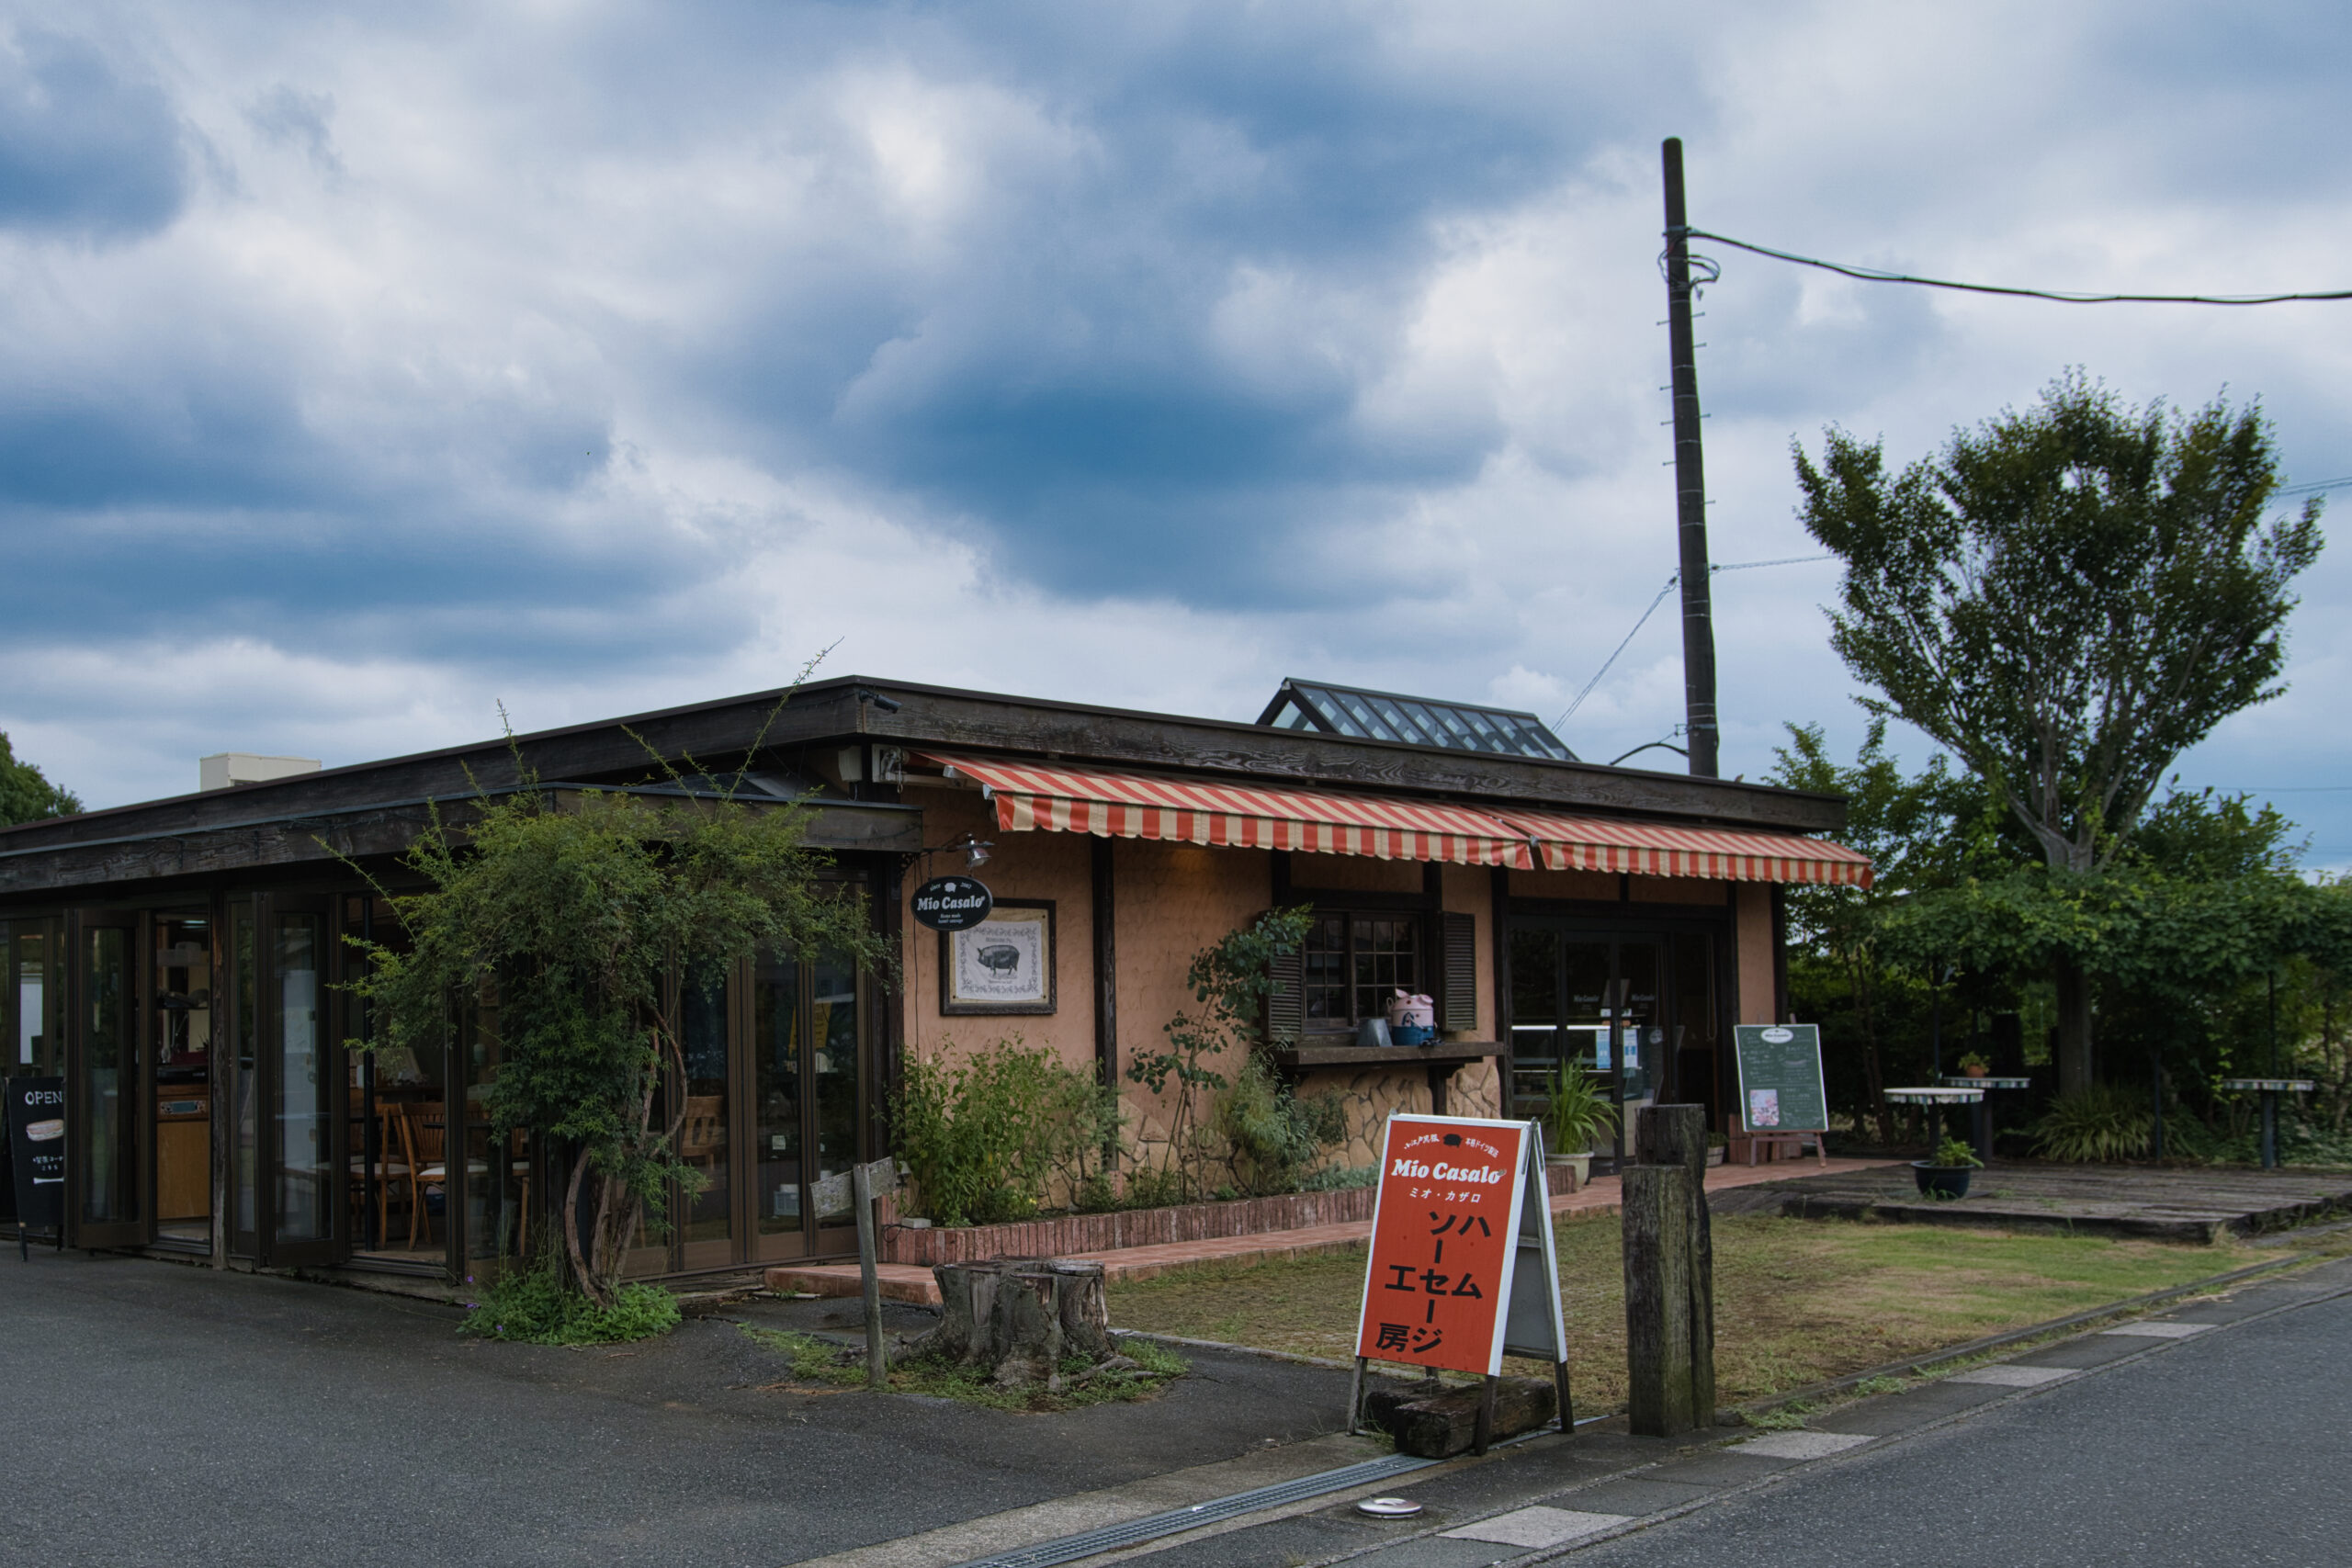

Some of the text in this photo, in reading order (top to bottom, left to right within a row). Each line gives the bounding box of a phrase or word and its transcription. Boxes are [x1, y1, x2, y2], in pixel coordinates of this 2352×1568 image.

[917, 895, 985, 911] Mio Casalo
[25, 1090, 62, 1105] OPEN
[1391, 1158, 1502, 1185] Mio Casalo
[1409, 1187, 1481, 1203] ミオ・カザロ
[1452, 1214, 1491, 1300] ハム
[1412, 1211, 1458, 1354] ソーセージ
[1375, 1265, 1417, 1353] 工房
